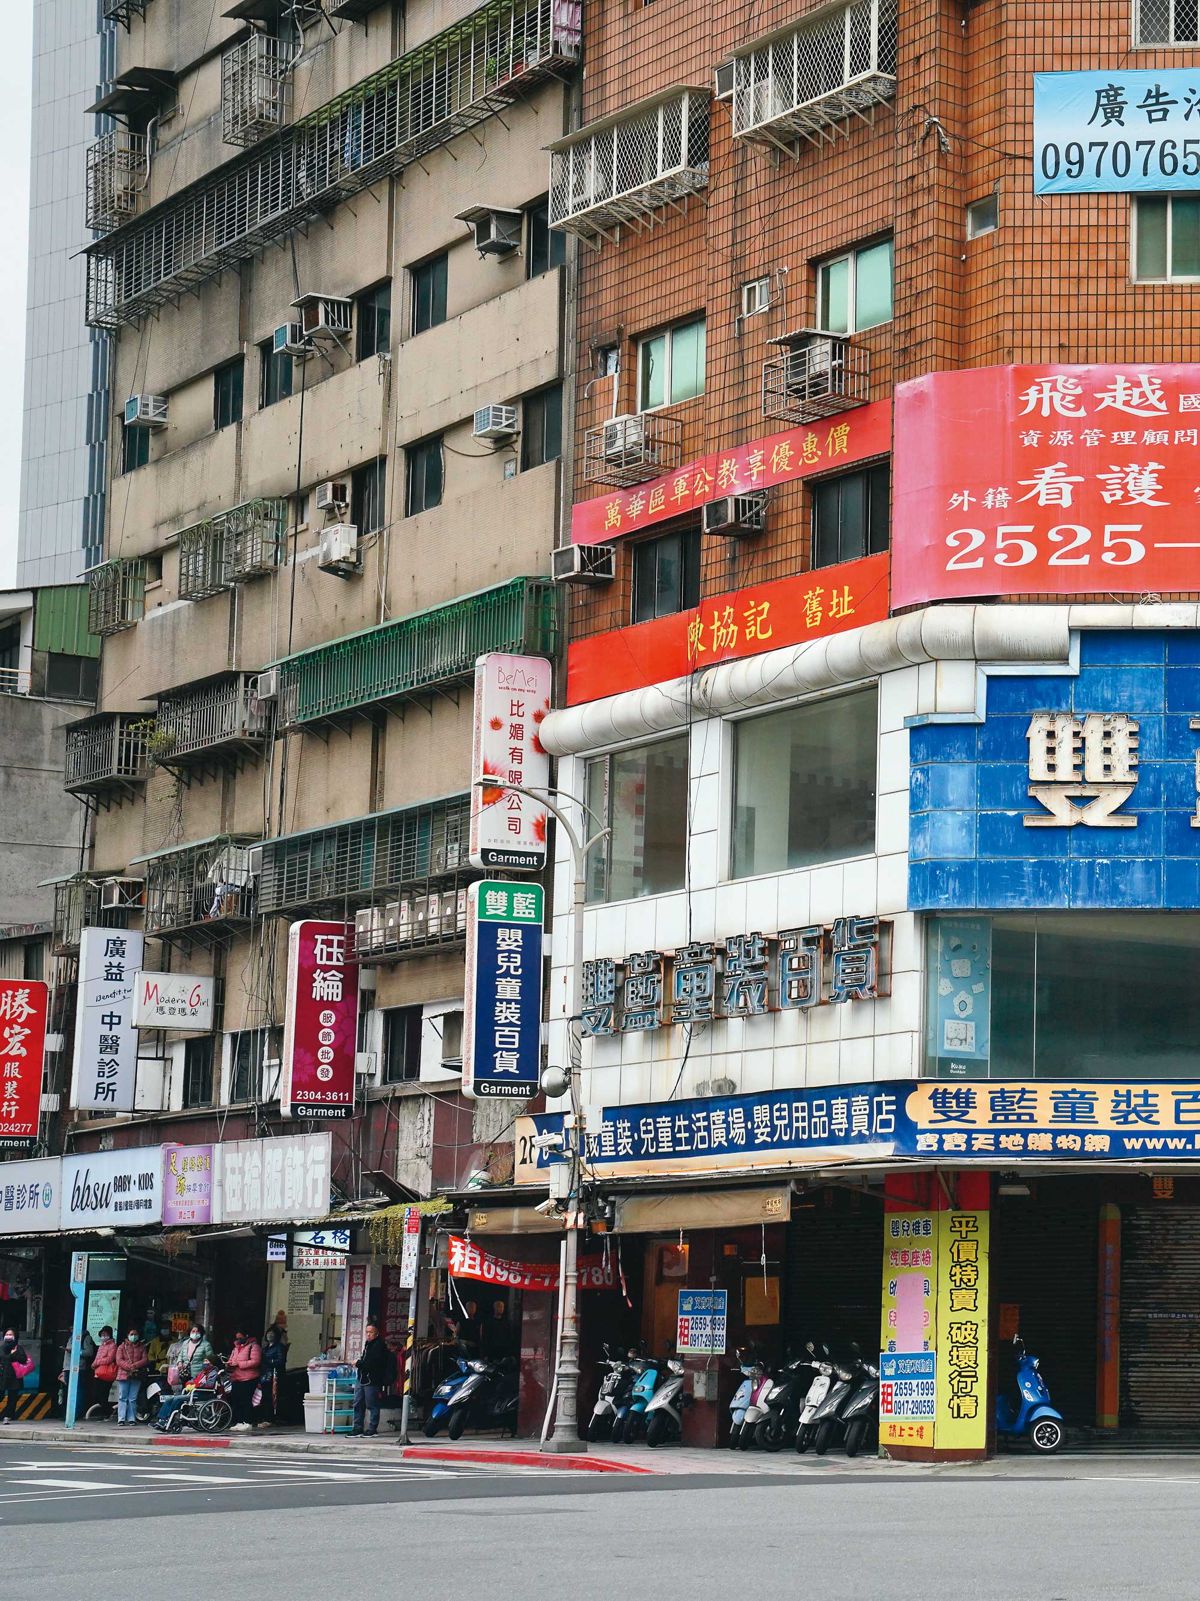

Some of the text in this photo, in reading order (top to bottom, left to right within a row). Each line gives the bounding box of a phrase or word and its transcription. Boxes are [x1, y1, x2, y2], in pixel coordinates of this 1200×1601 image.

[1018, 373, 1170, 419] 飛越
[604, 422, 852, 532] 萬華區軍公教享優惠價
[948, 486, 1012, 512] 外籍
[1016, 461, 1171, 509] 看護
[687, 584, 855, 662] 陳協記 舊址
[507, 699, 526, 836] 比媚有限公司
[488, 851, 538, 867] Garment
[485, 889, 537, 920] 雙藍
[103, 936, 127, 982] 廣益
[492, 927, 524, 1075] 嬰兒童裝百貨
[94, 1011, 122, 1103] 中醫診所
[297, 1090, 350, 1102] 2304-3611
[297, 1105, 347, 1118] Garment
[480, 1081, 531, 1097] Garment
[450, 1241, 482, 1277] 租
[949, 1215, 979, 1312] 平價特賣
[948, 1320, 979, 1419] 破壞行情
[881, 1381, 935, 1414] 租 2659-1999
[893, 1399, 935, 1415] 0917-290558
